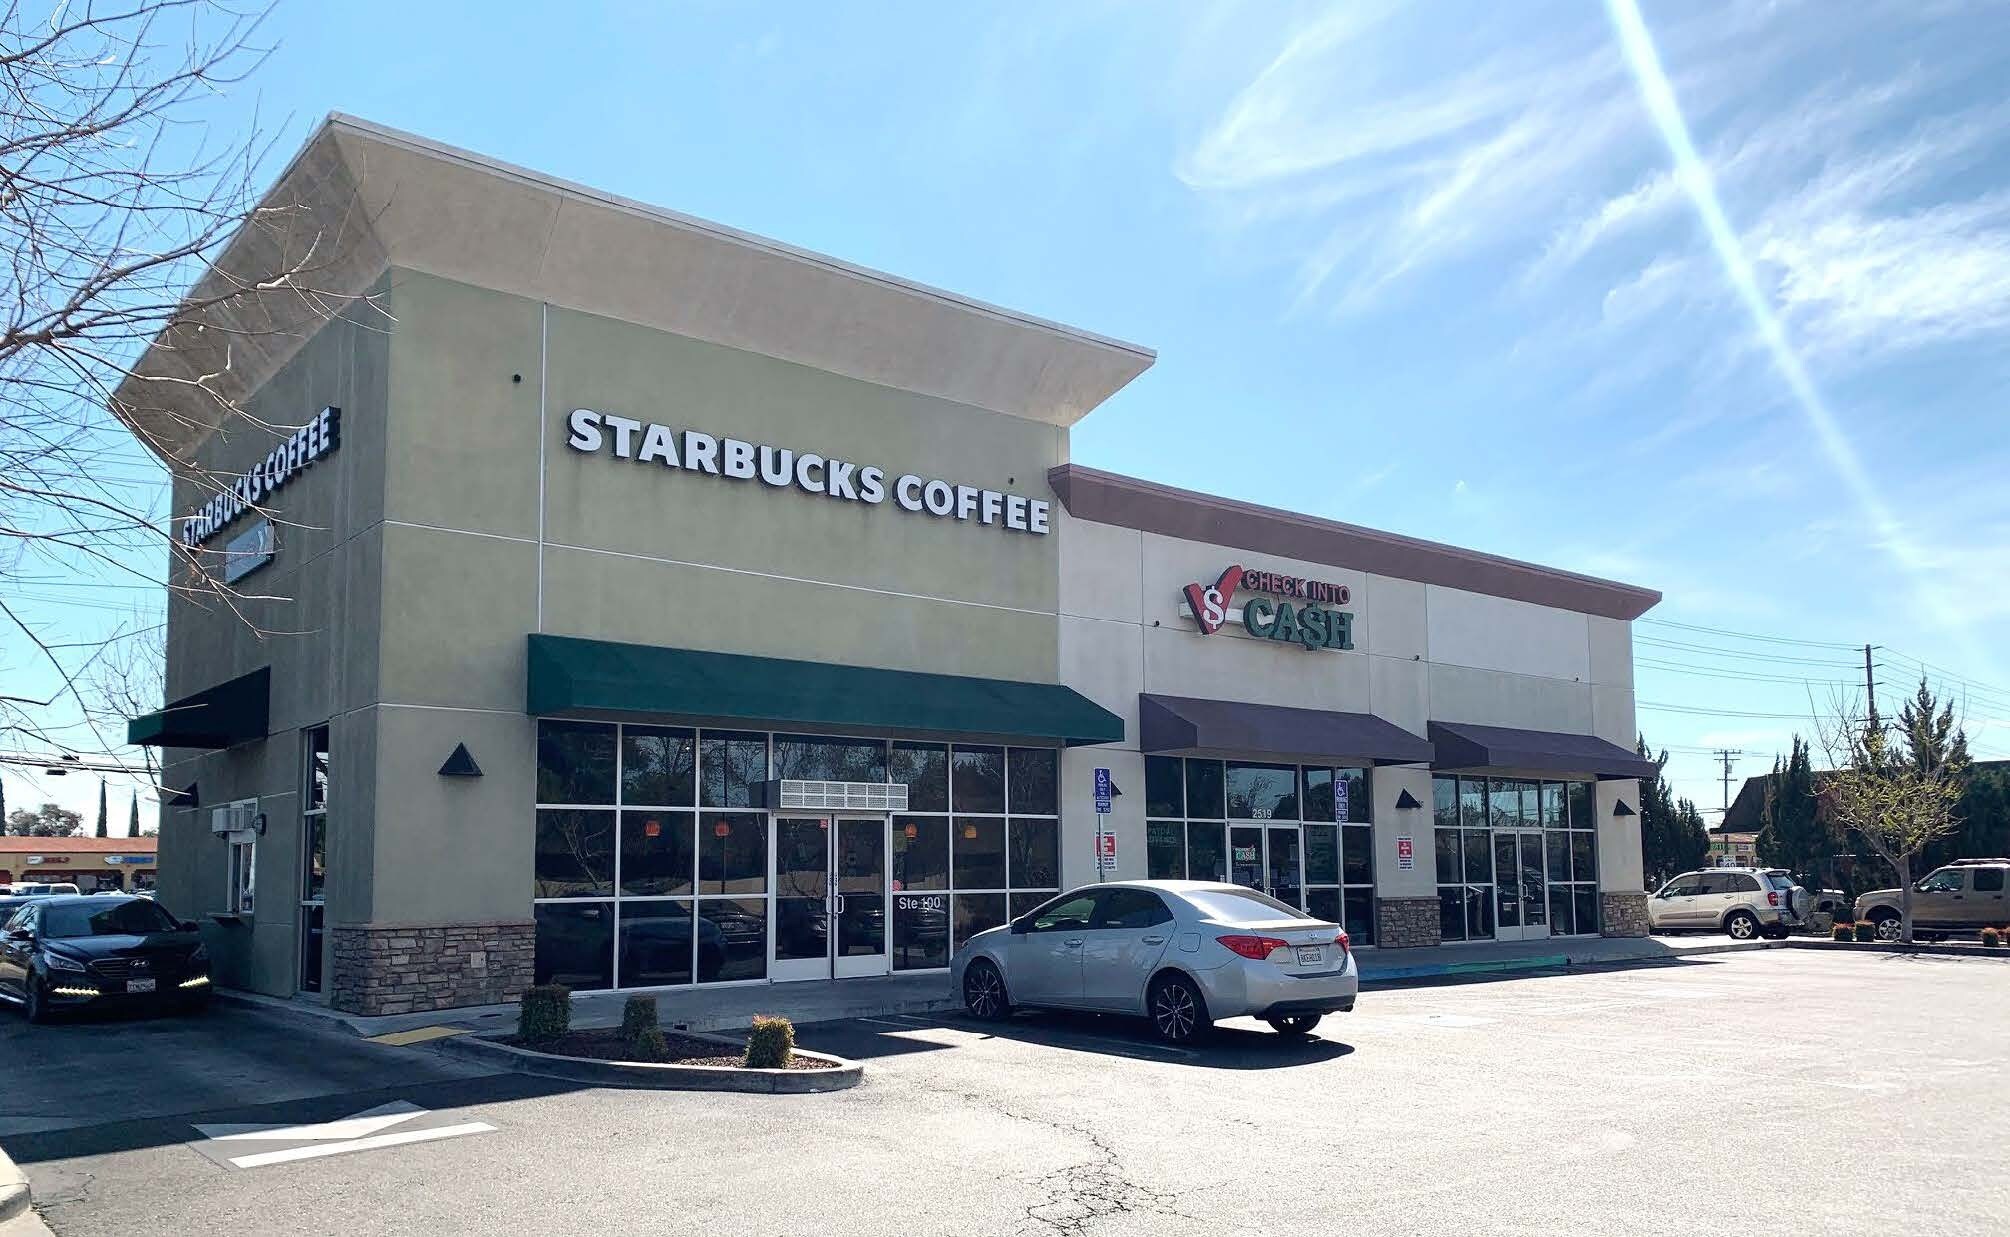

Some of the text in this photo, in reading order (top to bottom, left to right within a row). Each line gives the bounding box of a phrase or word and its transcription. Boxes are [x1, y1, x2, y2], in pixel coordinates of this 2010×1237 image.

[183, 406, 338, 547] STARBUCKS COFFEE
[567, 408, 1050, 534] STARBUCKS COFFEE
[1242, 569, 1350, 605] CHECK INTO
[1252, 808, 1272, 818] 2519
[899, 896, 941, 909] Ste 100
